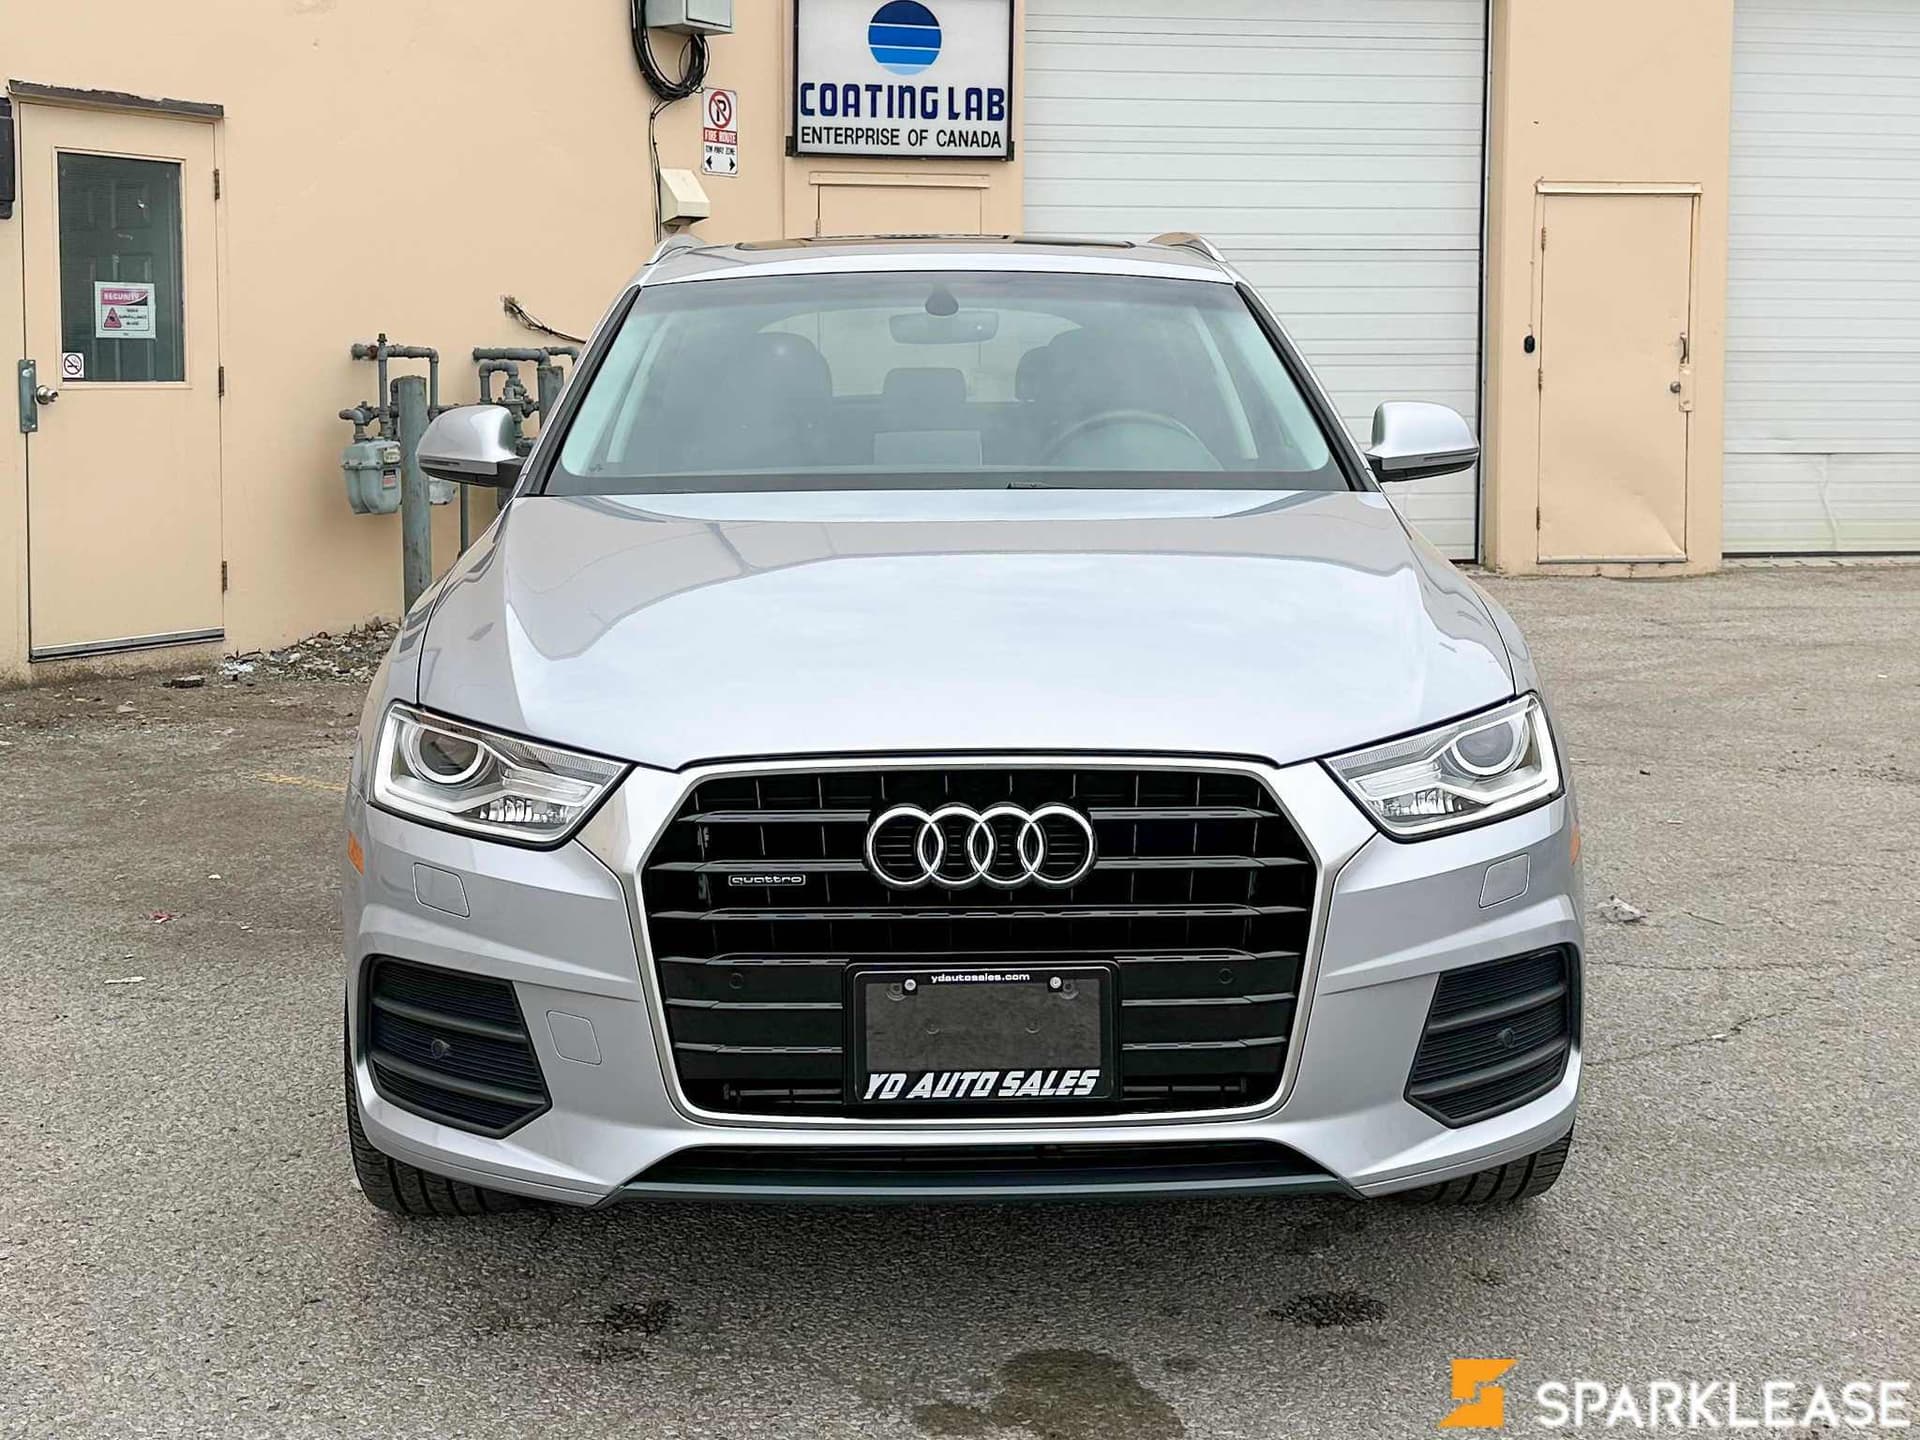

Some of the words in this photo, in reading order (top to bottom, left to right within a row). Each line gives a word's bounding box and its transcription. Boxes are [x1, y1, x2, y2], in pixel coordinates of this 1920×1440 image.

[800, 82, 939, 119] COATING
[948, 86, 1005, 121] LAB
[704, 129, 718, 141] FIRE
[719, 131, 737, 144] ROUTE
[801, 126, 900, 146] ENTERPRISE
[908, 129, 928, 147] OF
[936, 130, 1002, 149] CANADA
[103, 292, 142, 301] SECURITY
[732, 876, 802, 885] quattro
[931, 973, 1030, 984] ydautosales.com
[864, 1073, 907, 1099] YD
[906, 1071, 999, 1099] AUTO
[998, 1069, 1100, 1096] SALES
